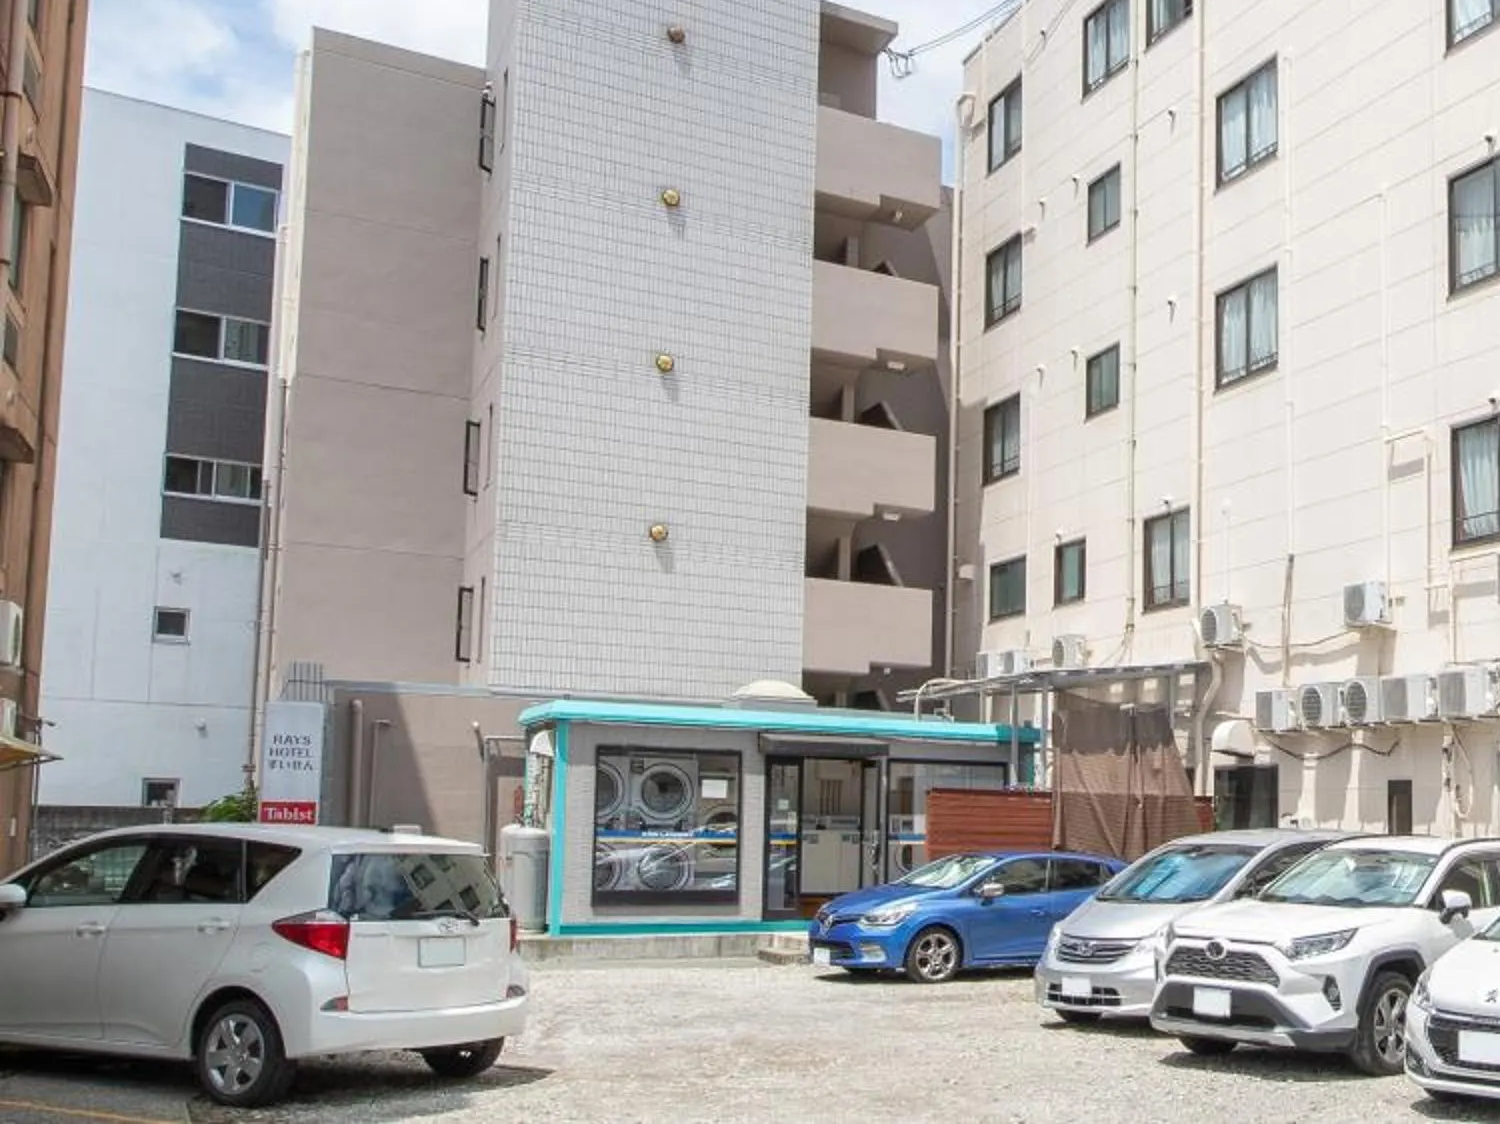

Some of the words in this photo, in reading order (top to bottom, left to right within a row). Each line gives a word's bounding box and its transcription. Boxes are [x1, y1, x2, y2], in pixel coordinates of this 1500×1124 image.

[272, 734, 311, 746] RAYS
[268, 747, 313, 758] HOTEL
[264, 806, 313, 821] Tabist
